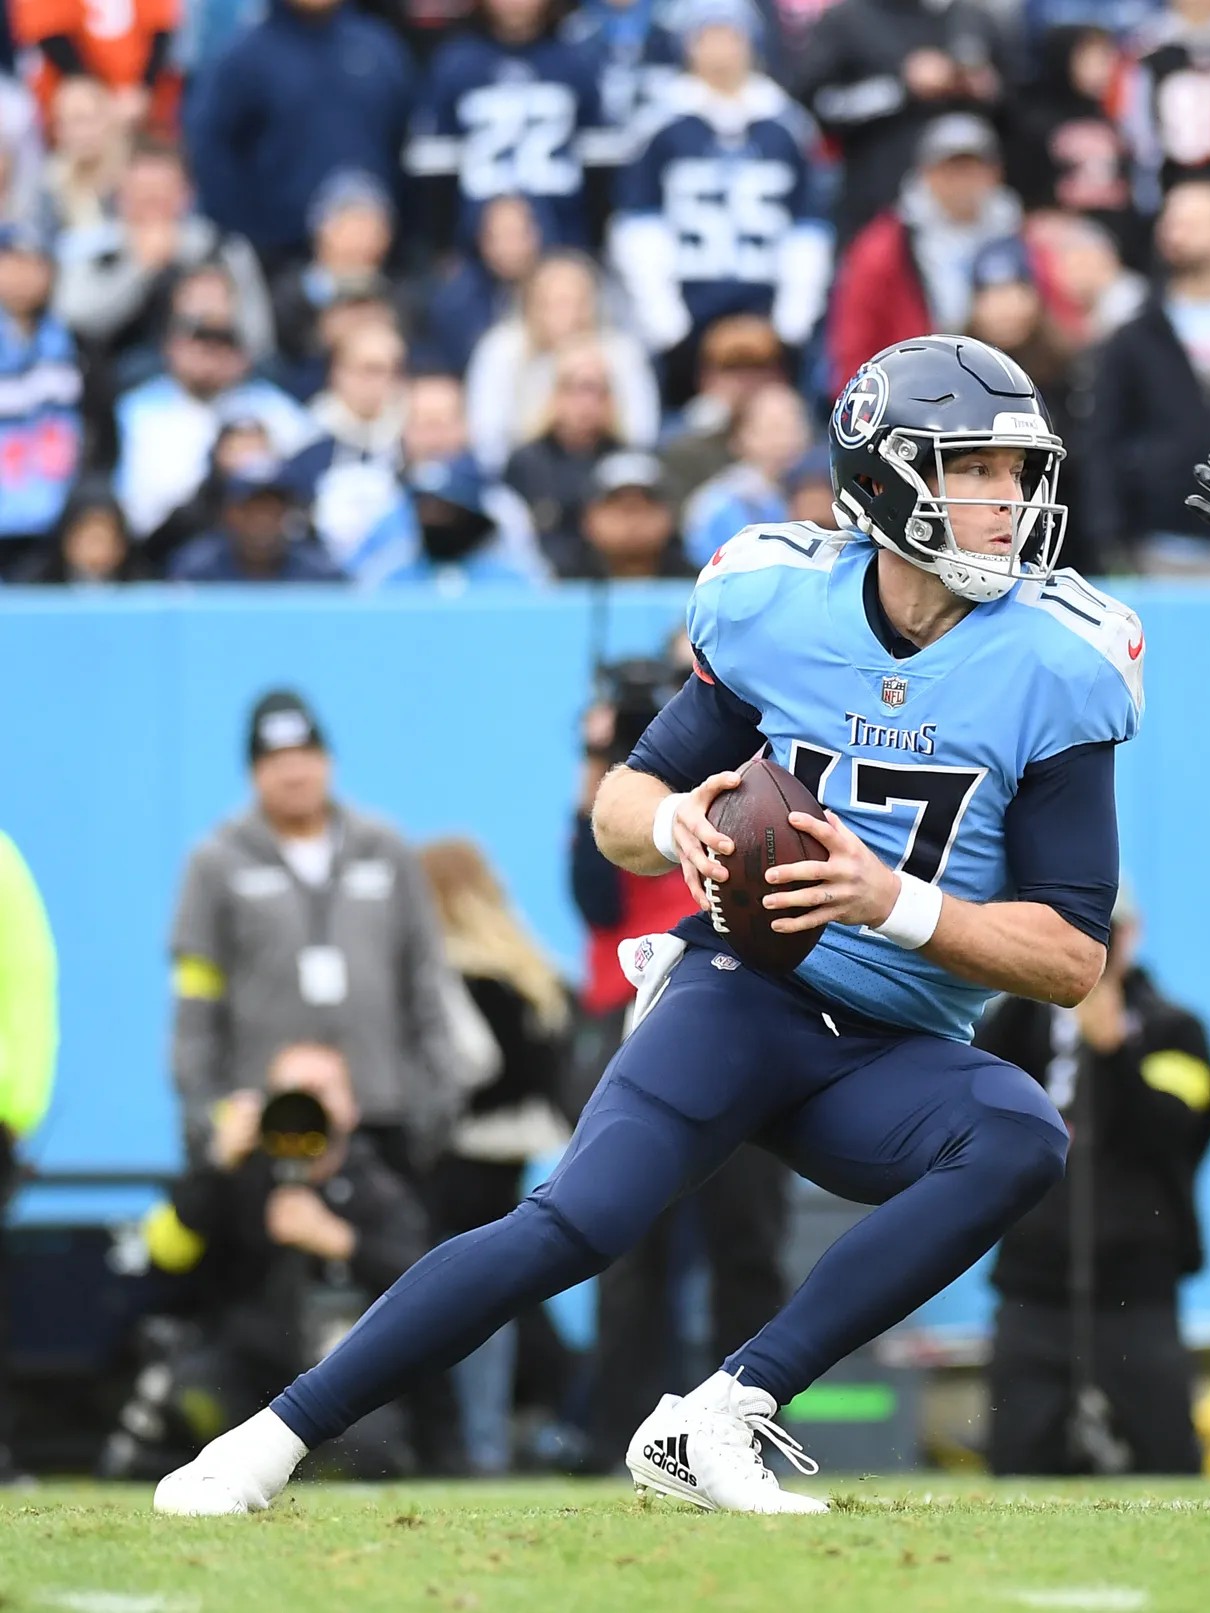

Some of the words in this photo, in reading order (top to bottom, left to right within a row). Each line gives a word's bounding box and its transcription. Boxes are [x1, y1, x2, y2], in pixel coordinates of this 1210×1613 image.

[883, 689, 903, 704] NFL
[844, 711, 938, 757] TITANS
[642, 1443, 699, 1488] adidas
